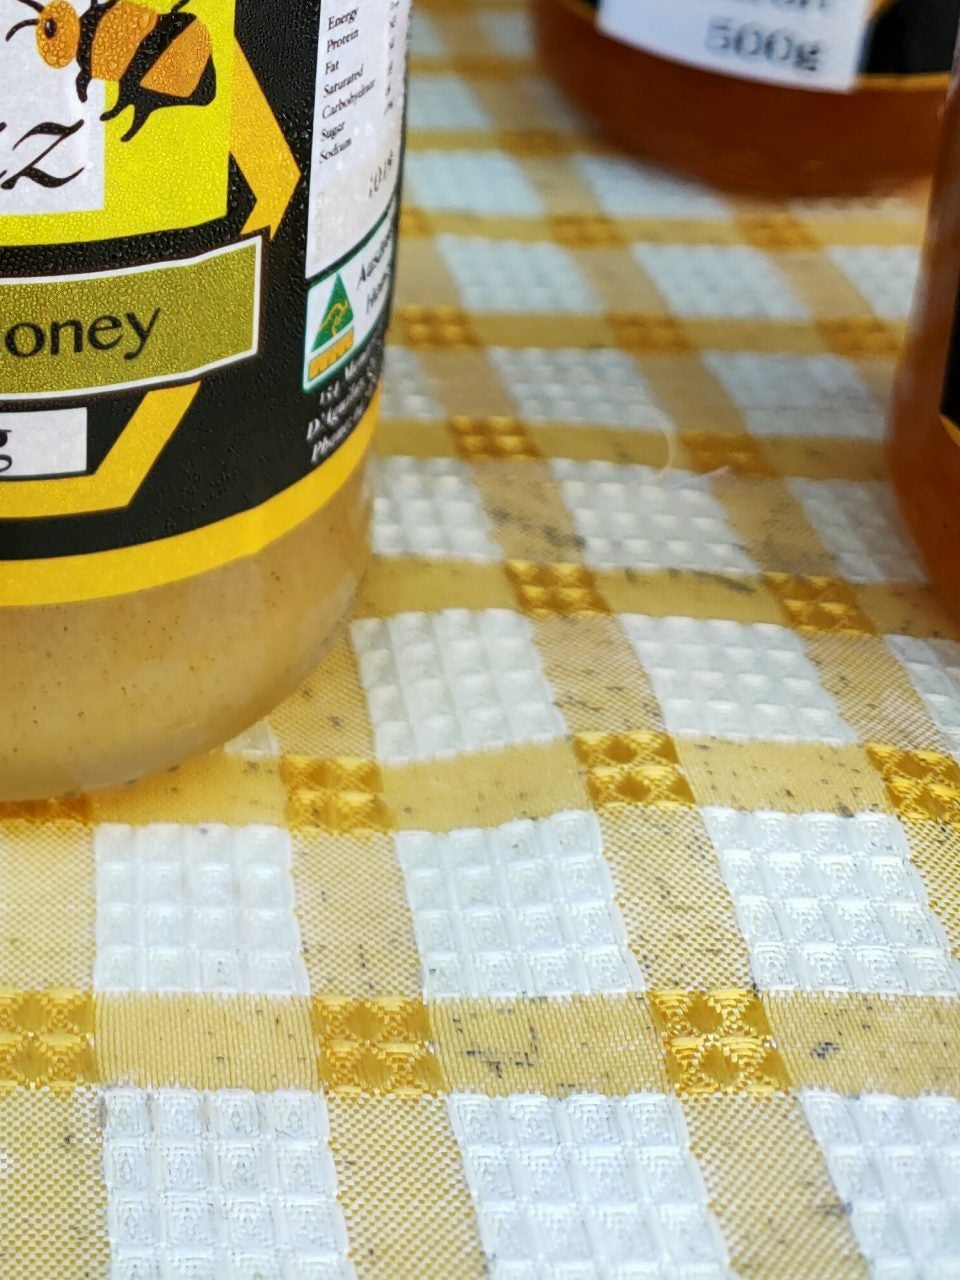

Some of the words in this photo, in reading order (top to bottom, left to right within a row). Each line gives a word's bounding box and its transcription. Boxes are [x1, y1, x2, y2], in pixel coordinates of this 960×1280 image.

[327, 7, 359, 31] Energy
[326, 29, 360, 53] Protein
[704, 16, 821, 72] 500g
[324, 60, 340, 76] Fat
